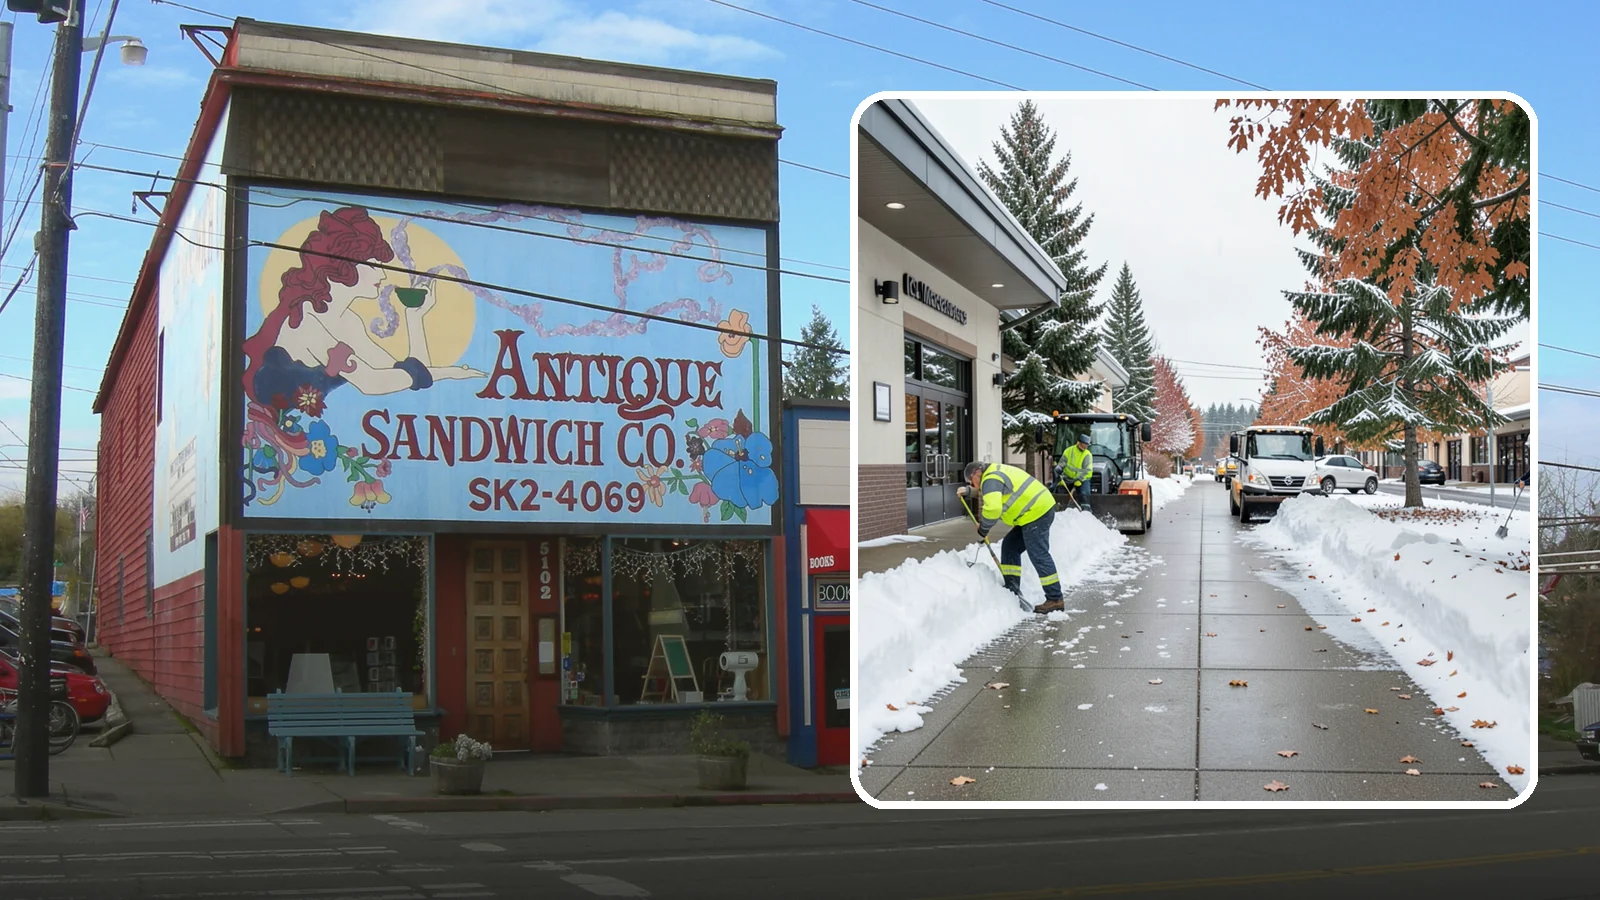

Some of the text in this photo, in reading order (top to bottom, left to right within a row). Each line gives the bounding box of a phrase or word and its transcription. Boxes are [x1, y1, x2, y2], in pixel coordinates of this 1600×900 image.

[477, 329, 723, 420] ANTIQUE
[361, 408, 684, 470] SANDWICH CO.
[468, 477, 646, 513] SK2-4069
[539, 542, 552, 599] 5102
[809, 555, 834, 569] BOOKS
